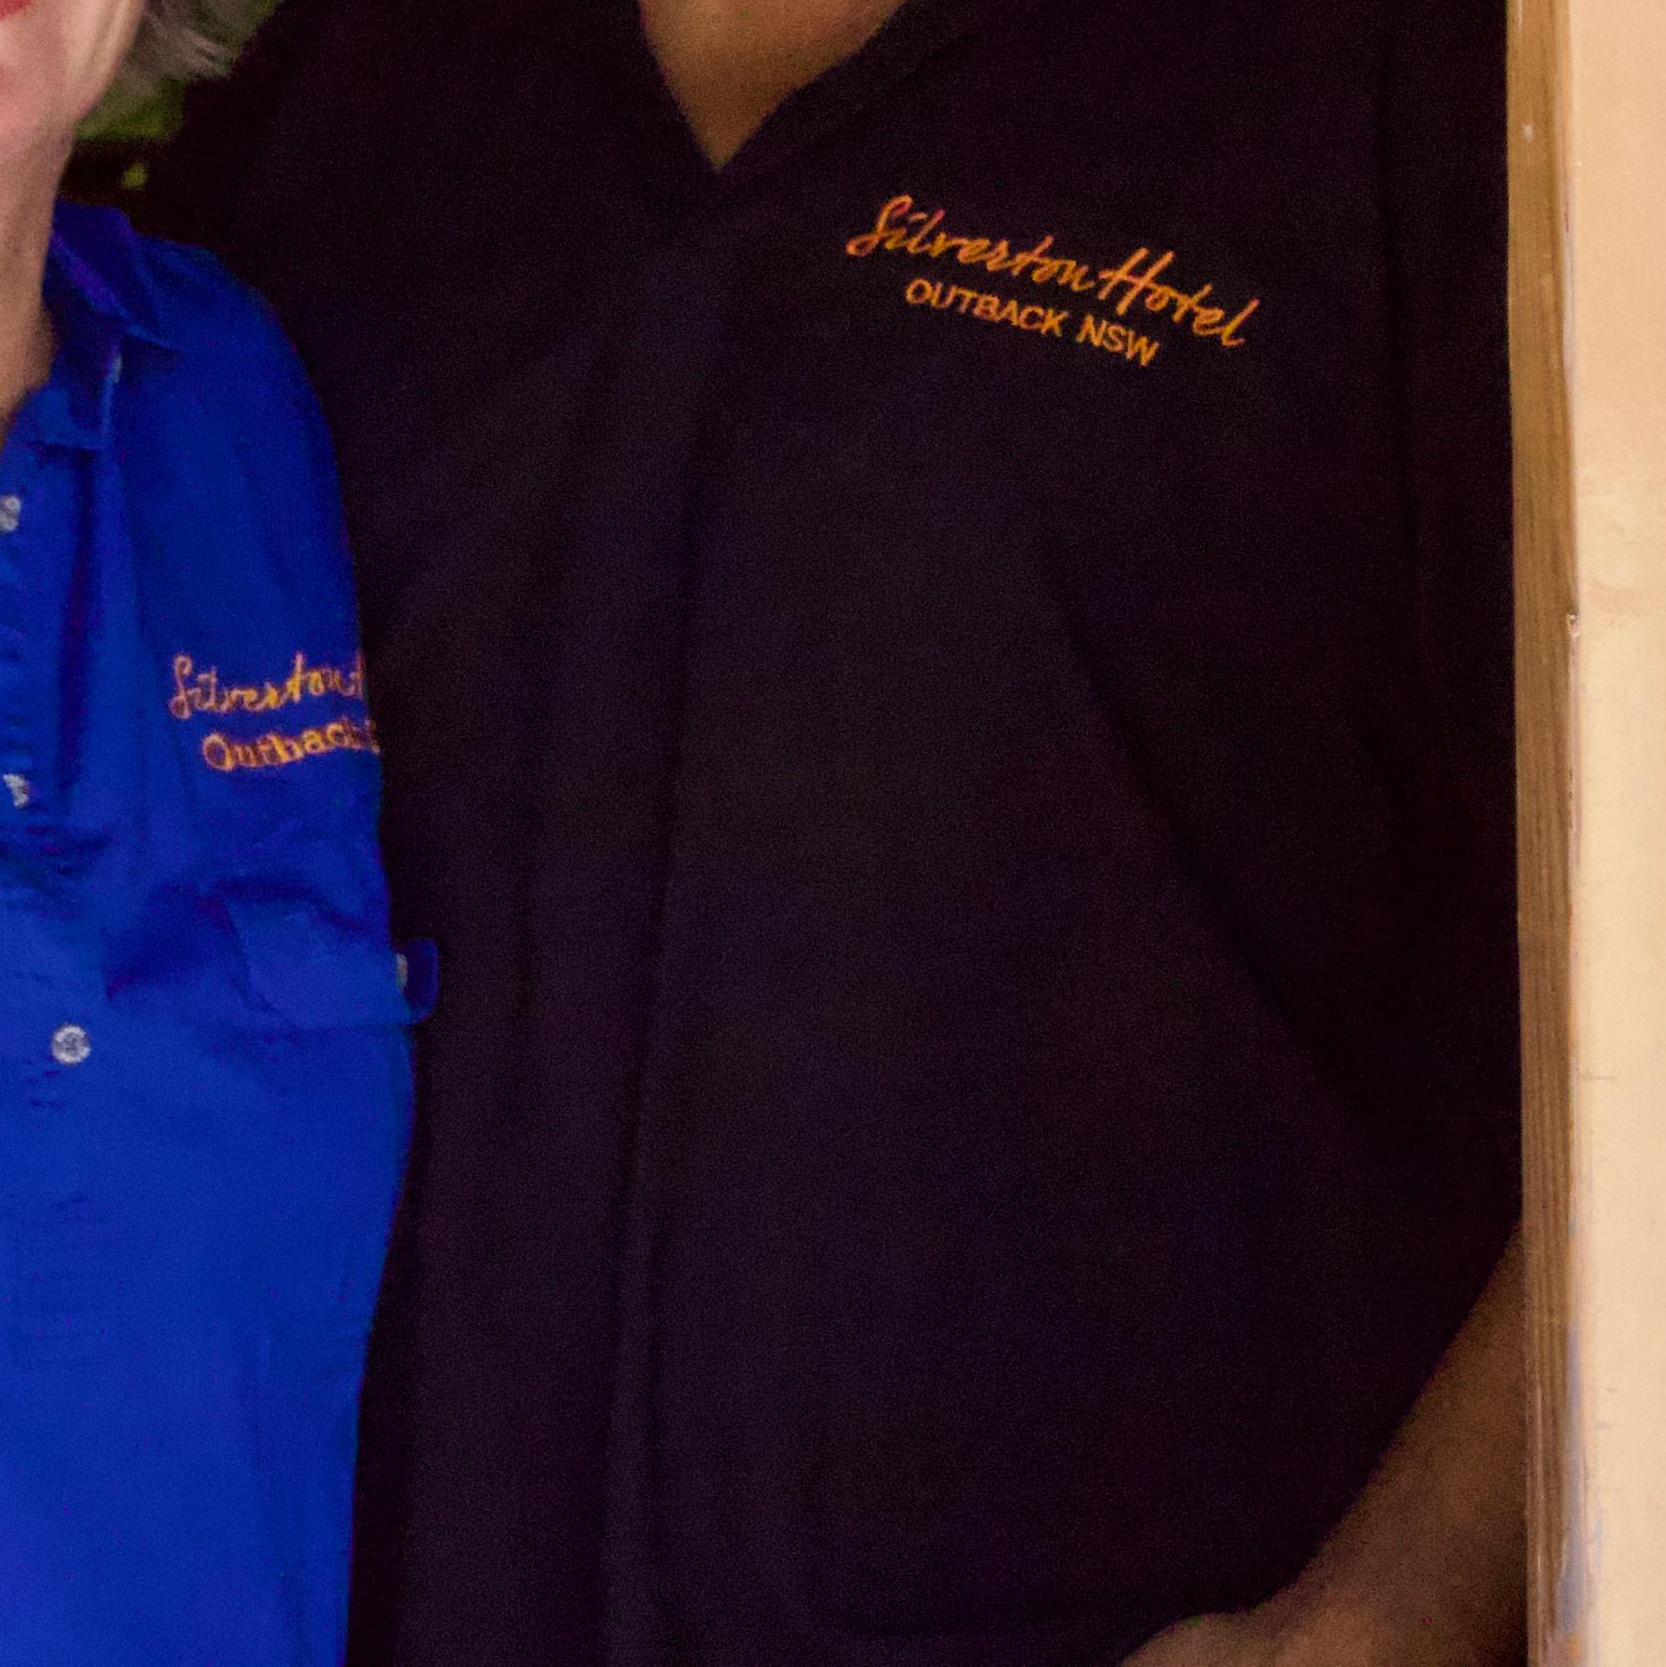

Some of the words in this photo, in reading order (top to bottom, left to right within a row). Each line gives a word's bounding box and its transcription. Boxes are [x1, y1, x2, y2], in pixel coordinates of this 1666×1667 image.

[845, 194, 1095, 292] Silverton
[1098, 247, 1261, 346] Hotel
[905, 278, 1069, 337] OUTBACK
[1076, 314, 1160, 368] NSW
